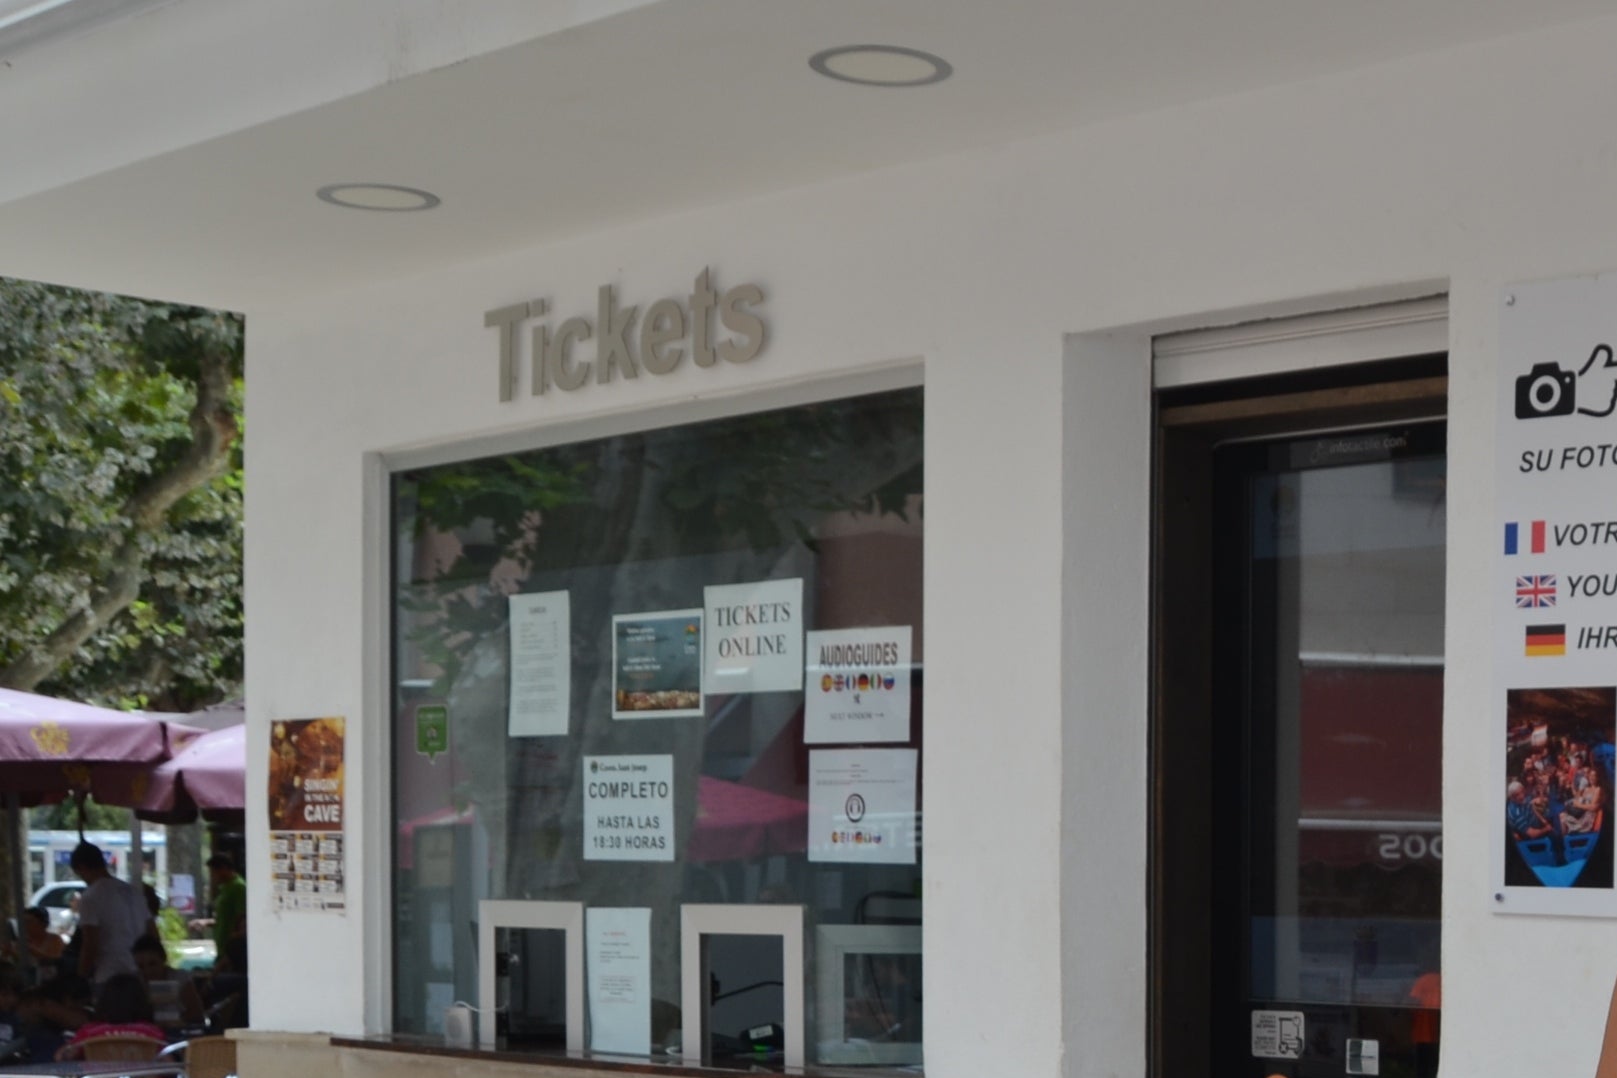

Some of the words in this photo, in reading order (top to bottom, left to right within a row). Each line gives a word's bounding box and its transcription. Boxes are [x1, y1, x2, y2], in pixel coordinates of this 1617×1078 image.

[483, 265, 765, 403] Tickets
[1519, 449, 1553, 473] SU
[714, 602, 791, 627] TICKETS
[718, 634, 786, 658] ONLINE
[819, 642, 899, 667] AUDIOGUIDES
[588, 781, 668, 800] COMPLETO
[304, 804, 341, 823] CAVE
[597, 815, 635, 829] HASTA
[637, 815, 660, 829] LAS
[593, 836, 622, 850] 18:30
[624, 836, 666, 850] HORAS
